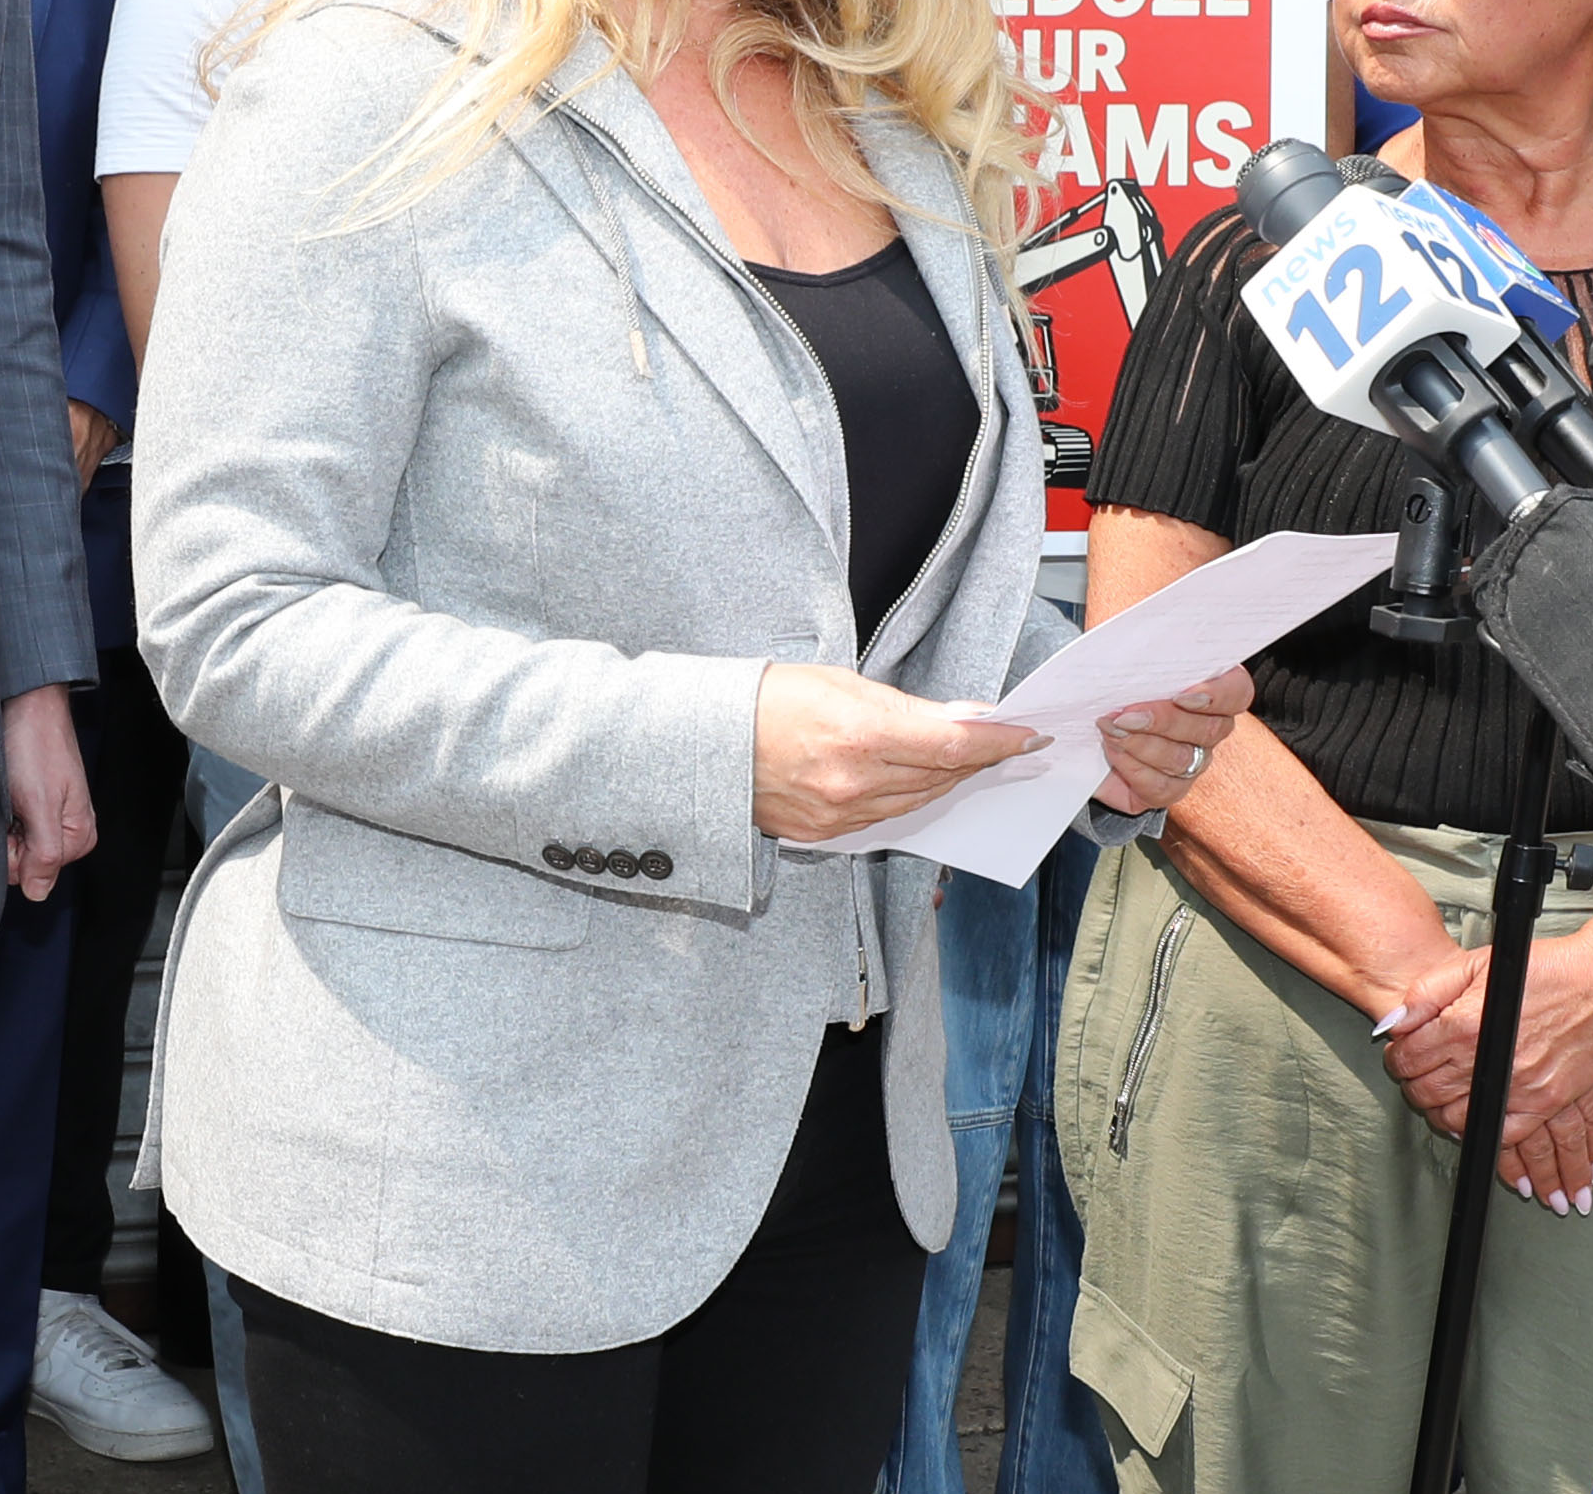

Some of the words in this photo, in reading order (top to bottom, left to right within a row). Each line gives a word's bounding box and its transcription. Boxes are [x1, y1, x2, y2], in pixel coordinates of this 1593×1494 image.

[1013, 100, 1255, 189] AMS
[1261, 209, 1357, 307] news
[1400, 230, 1506, 319] 12
[1285, 243, 1414, 372] 12
